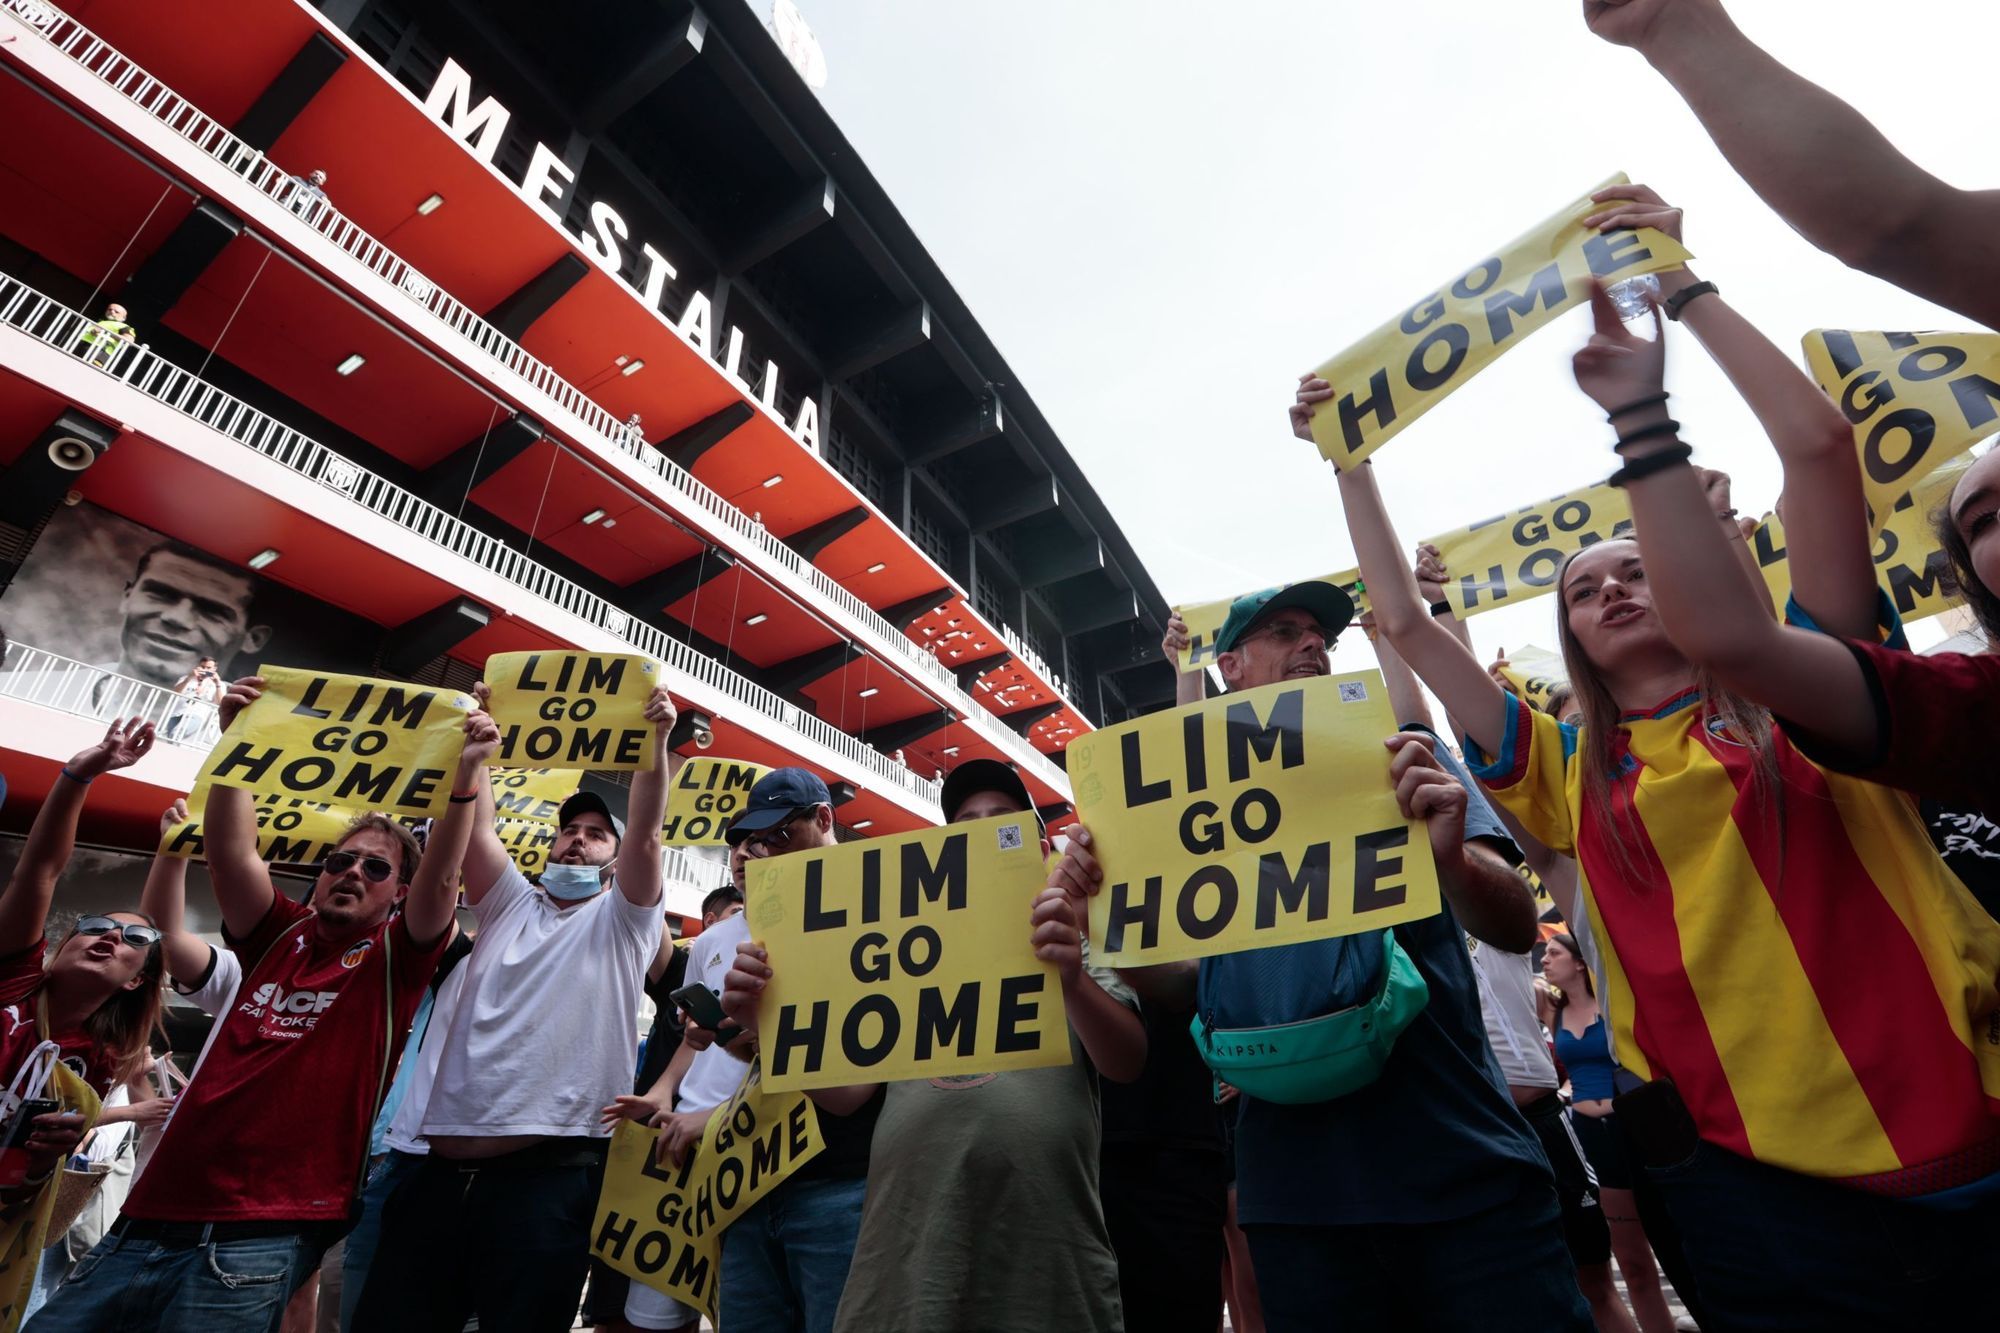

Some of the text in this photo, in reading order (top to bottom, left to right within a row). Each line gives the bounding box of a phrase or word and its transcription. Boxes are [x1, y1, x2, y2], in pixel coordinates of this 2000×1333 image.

[424, 57, 821, 456] MESTALLA
[1400, 257, 1502, 335] GO
[1337, 226, 1653, 454] HOME
[1841, 345, 1967, 424] GO
[1512, 500, 1591, 547] GO
[517, 655, 627, 695] LIM
[1002, 622, 1053, 688] VALENCIA
[291, 677, 436, 729] LIM
[539, 697, 597, 721] GO
[312, 726, 389, 756] GO
[496, 723, 647, 764] HOME
[1120, 689, 1305, 809] LIM
[211, 742, 446, 808] HOME
[679, 763, 757, 791] LIM
[694, 793, 736, 812] GO
[1179, 787, 1282, 855] GO
[804, 833, 968, 933] LIM
[1103, 825, 1409, 954] HOME
[850, 925, 942, 983] GO
[771, 973, 1045, 1076] HOME
[1216, 1044, 1279, 1057] KIPSTA
[715, 1101, 756, 1154] GO
[641, 1136, 697, 1190] LI
[696, 1099, 809, 1238] HOME
